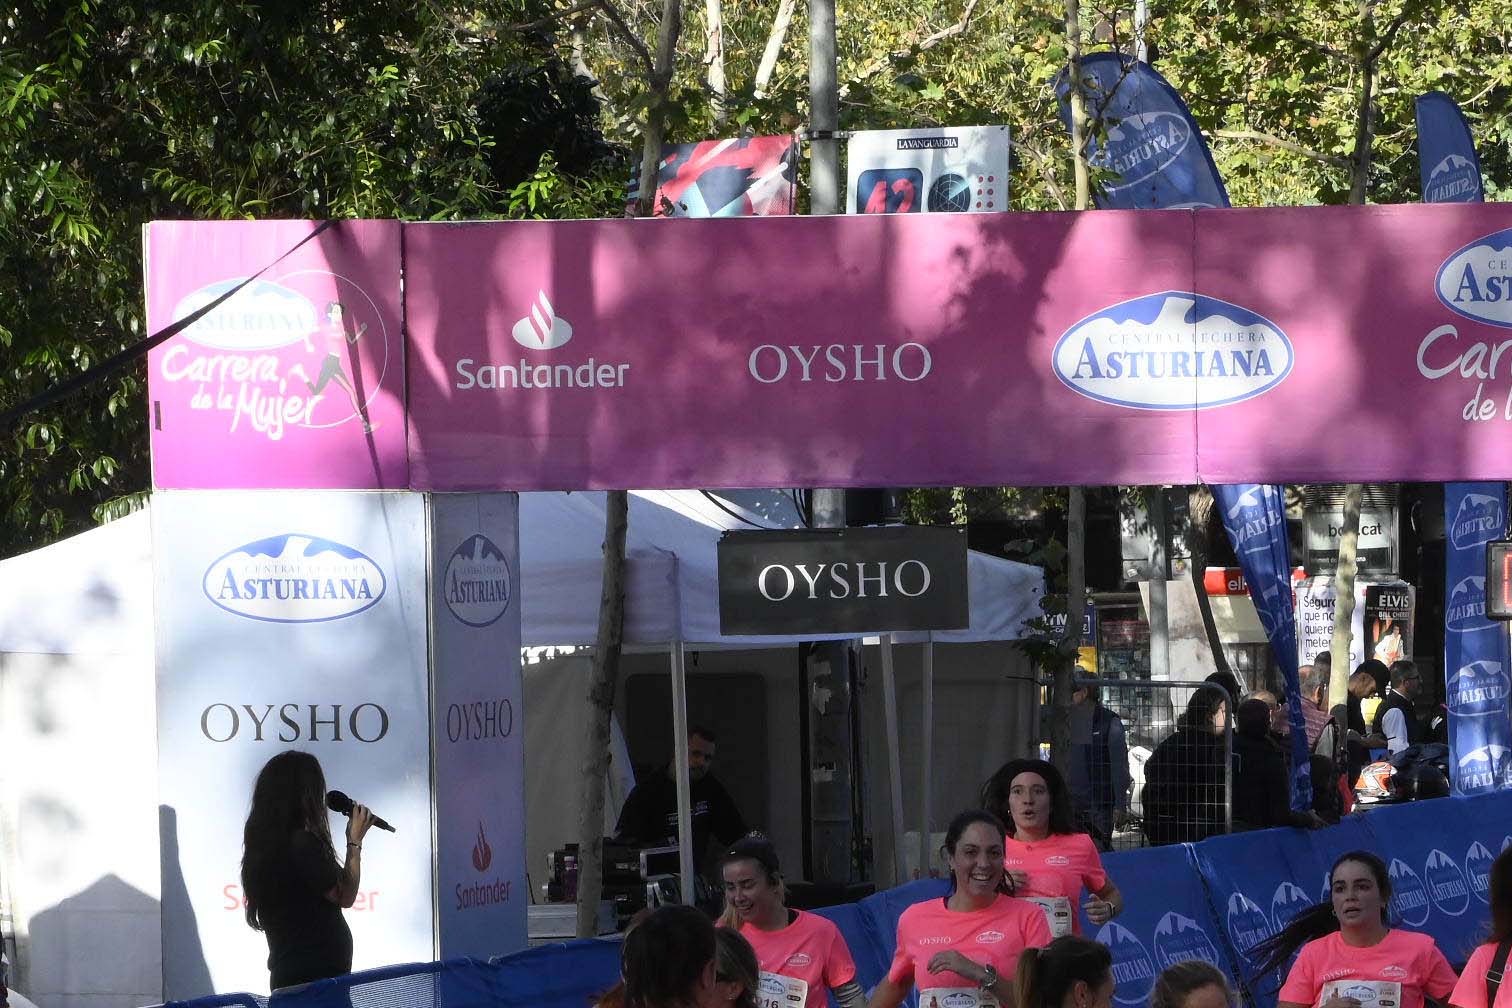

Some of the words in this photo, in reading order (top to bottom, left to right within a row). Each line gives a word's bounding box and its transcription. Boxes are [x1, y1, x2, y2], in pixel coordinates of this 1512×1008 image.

[1072, 335, 1275, 380] ASTURIANA
[1108, 332, 1182, 345] CENTRAL
[161, 344, 279, 383] Carrera
[456, 358, 629, 389] Santander
[748, 341, 933, 384] OYSHO
[231, 378, 324, 440] Mujer
[1462, 382, 1497, 421] de
[217, 567, 374, 601] ASTURIANA
[449, 570, 507, 605] ASTURIANA
[758, 559, 932, 601] OYSHO
[1379, 594, 1409, 607] ELVIS
[200, 703, 390, 743] OYSHO
[446, 699, 513, 743] OYSHO
[455, 880, 511, 911] Santander
